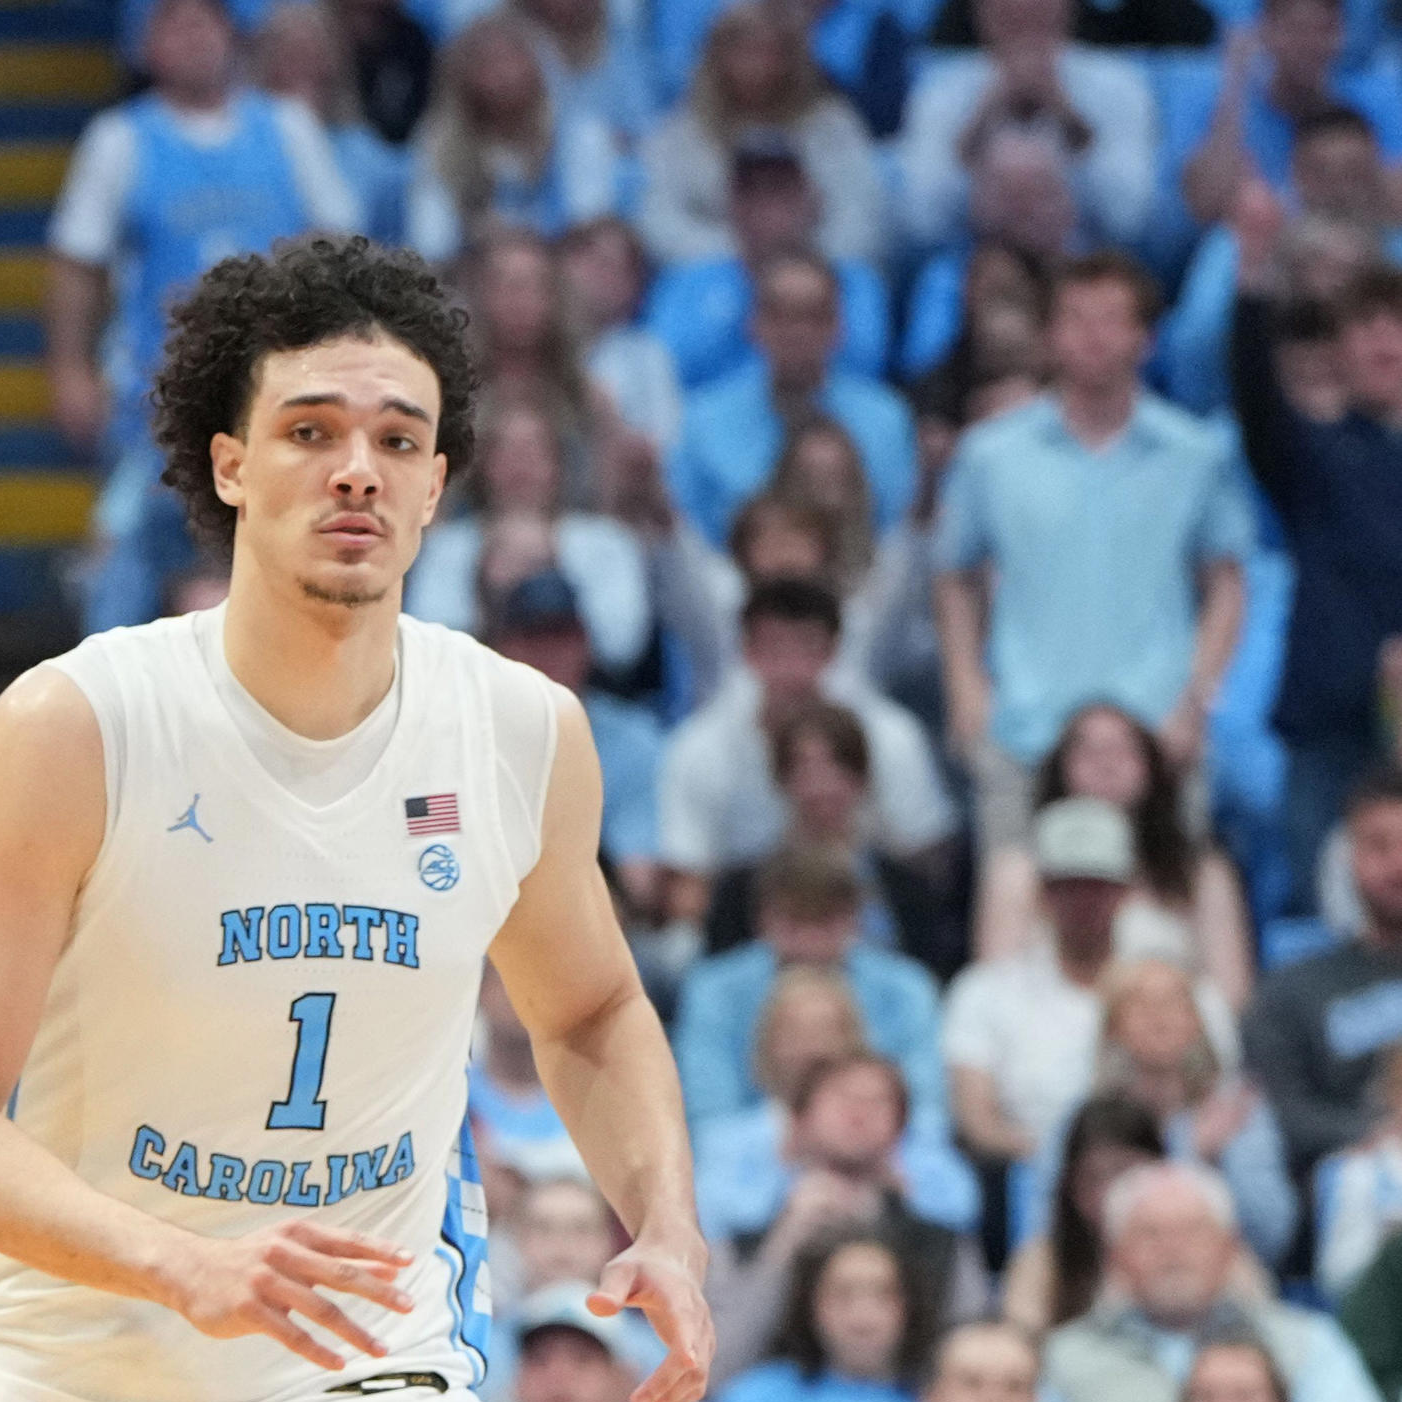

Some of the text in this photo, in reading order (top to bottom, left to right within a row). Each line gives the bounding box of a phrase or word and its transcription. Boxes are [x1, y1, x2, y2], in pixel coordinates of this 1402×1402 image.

[217, 903, 419, 968] NORTH
[265, 992, 336, 1131] 1
[129, 1124, 415, 1207] CAROLINA
